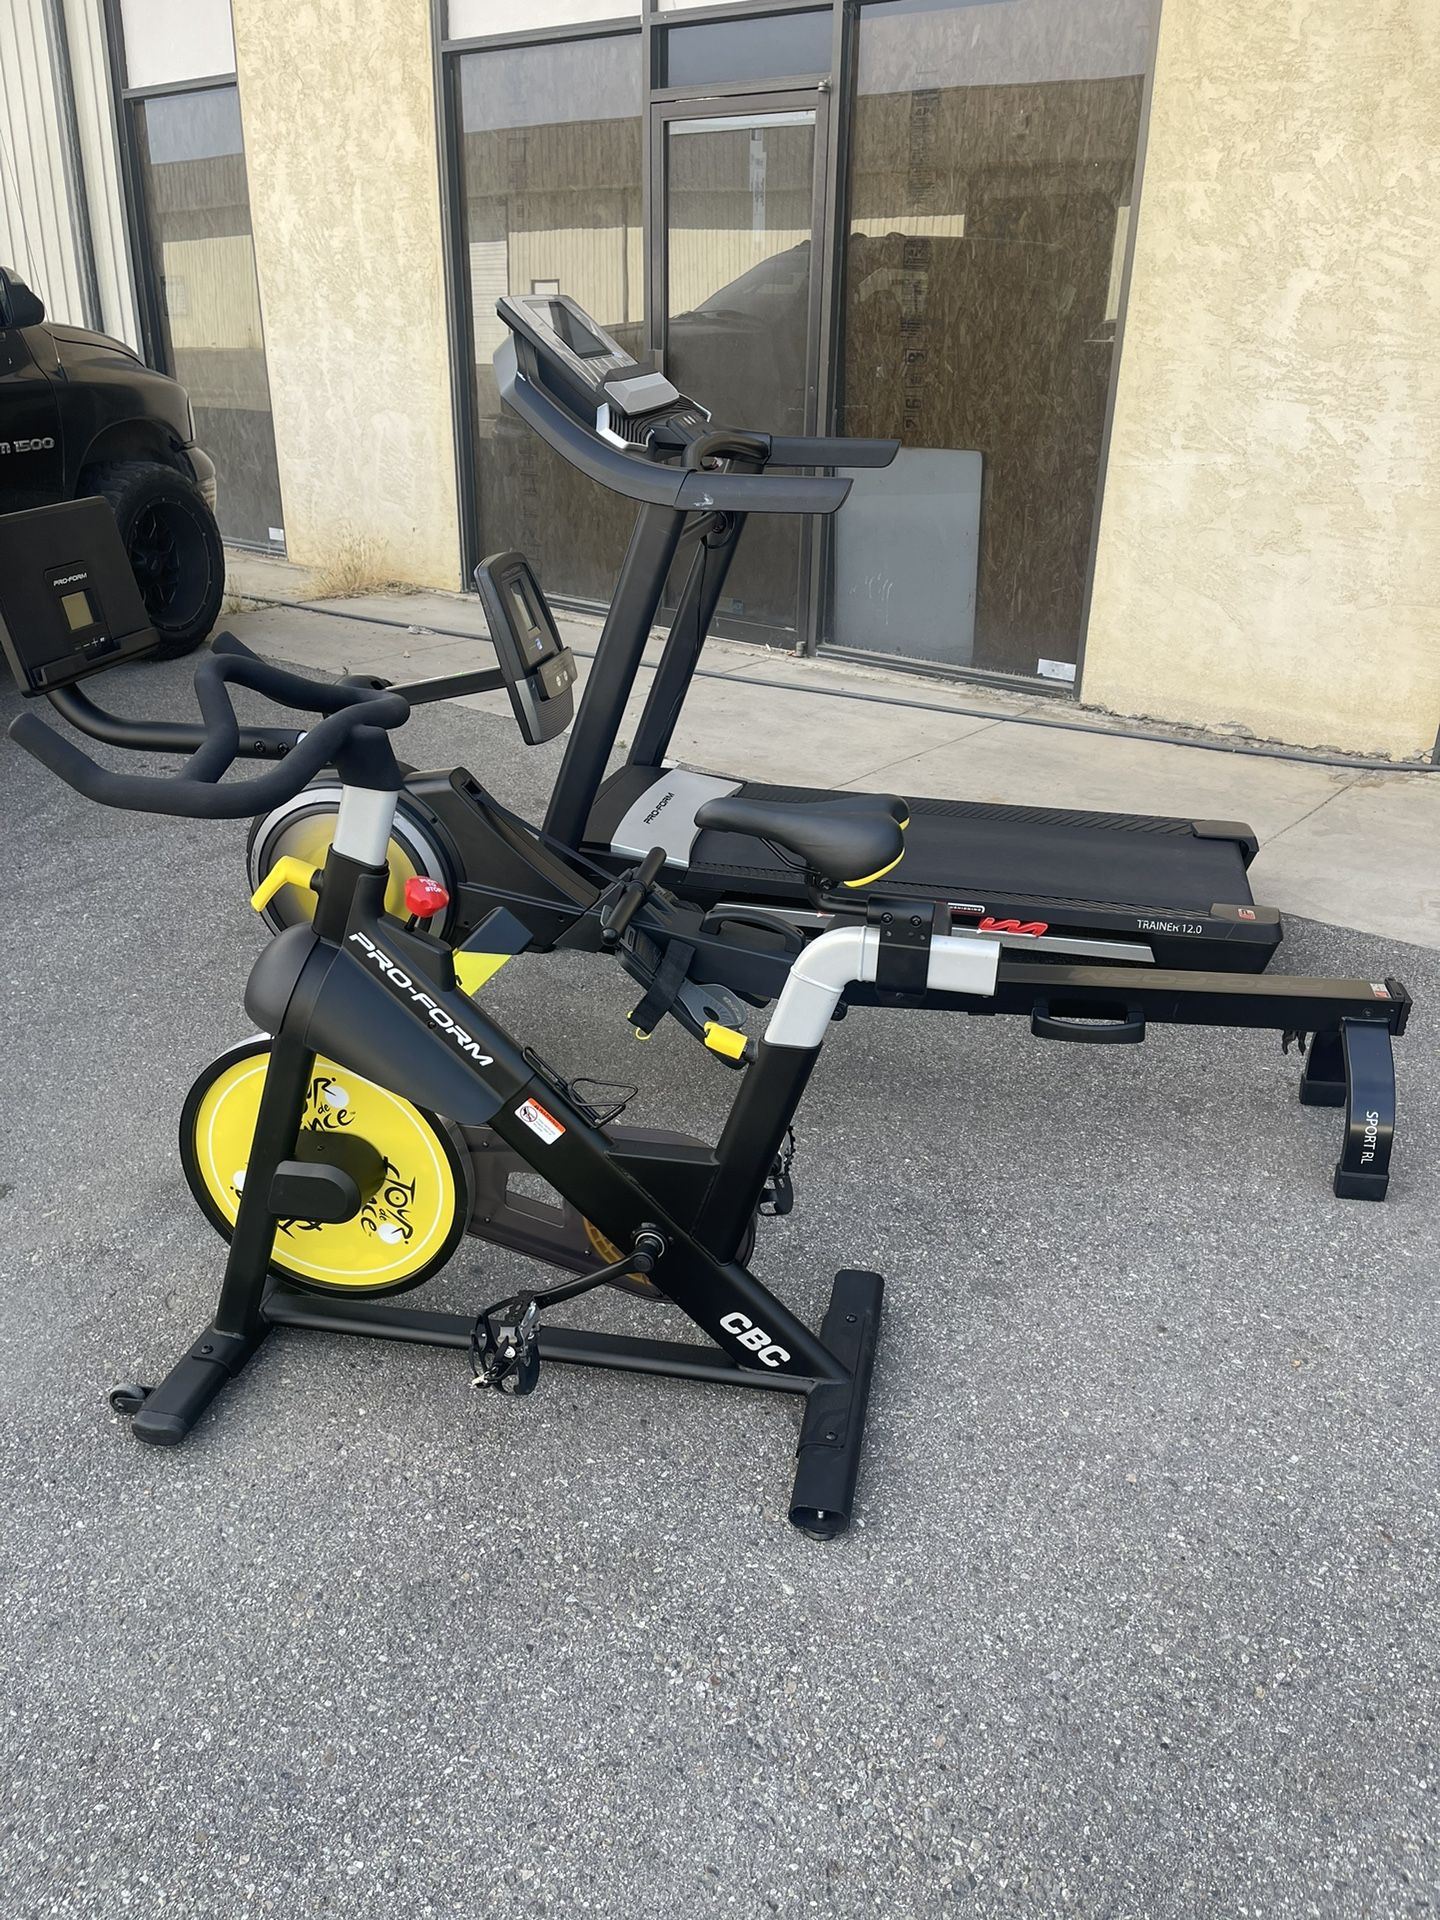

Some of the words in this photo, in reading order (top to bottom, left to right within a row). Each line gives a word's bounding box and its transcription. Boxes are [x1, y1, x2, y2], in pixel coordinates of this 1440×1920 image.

[13, 437, 55, 453] 1500
[53, 572, 88, 587] PRO-FORM
[643, 792, 675, 825] PRO-FORM
[1182, 924, 1203, 934] 12.0
[348, 932, 494, 1067] PRO-FORM
[1363, 1110, 1379, 1150] SPORT
[1360, 1151, 1374, 1165] RL
[720, 1311, 791, 1368] CBC
